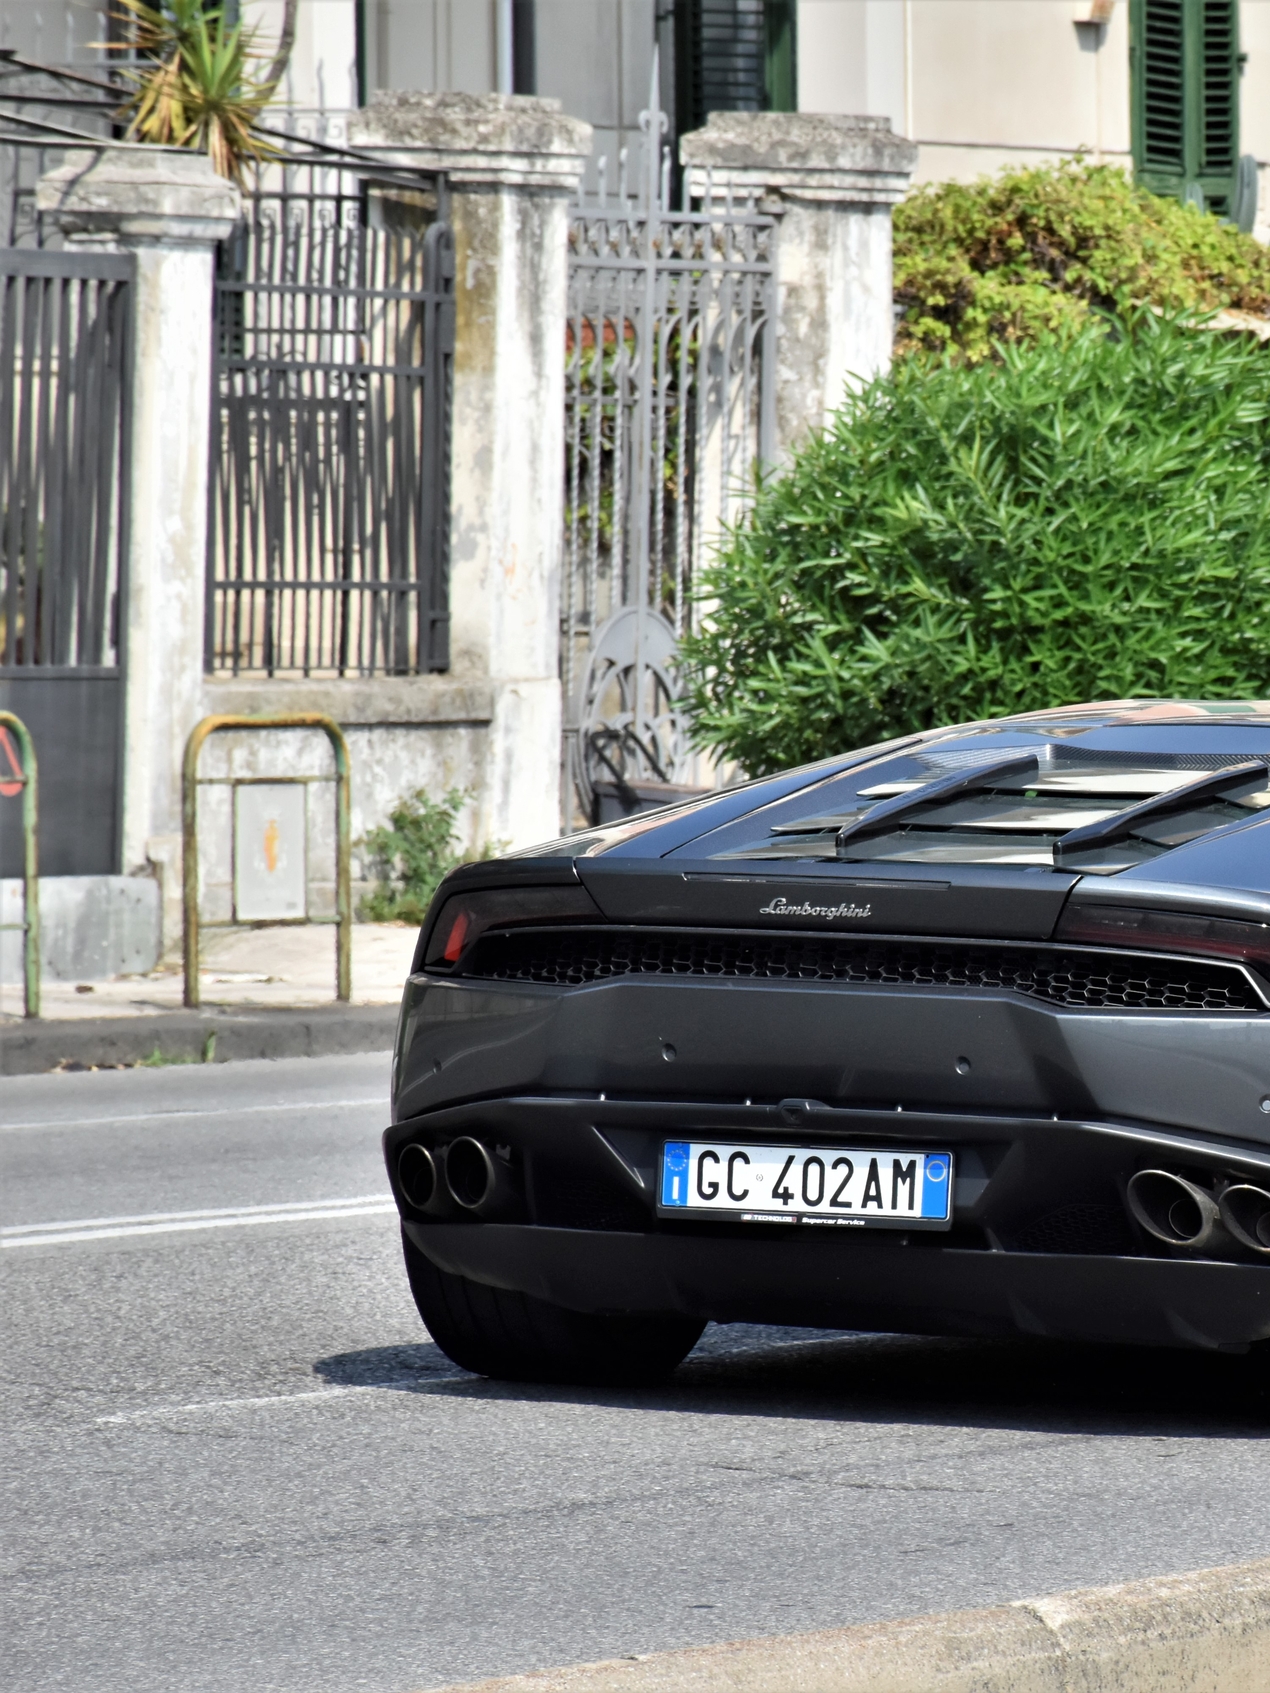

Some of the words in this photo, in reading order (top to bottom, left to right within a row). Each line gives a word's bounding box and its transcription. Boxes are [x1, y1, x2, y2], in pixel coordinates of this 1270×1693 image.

[759, 897, 872, 920] Lamborghini
[696, 1149, 751, 1202] GC
[771, 1154, 918, 1212] 402AM
